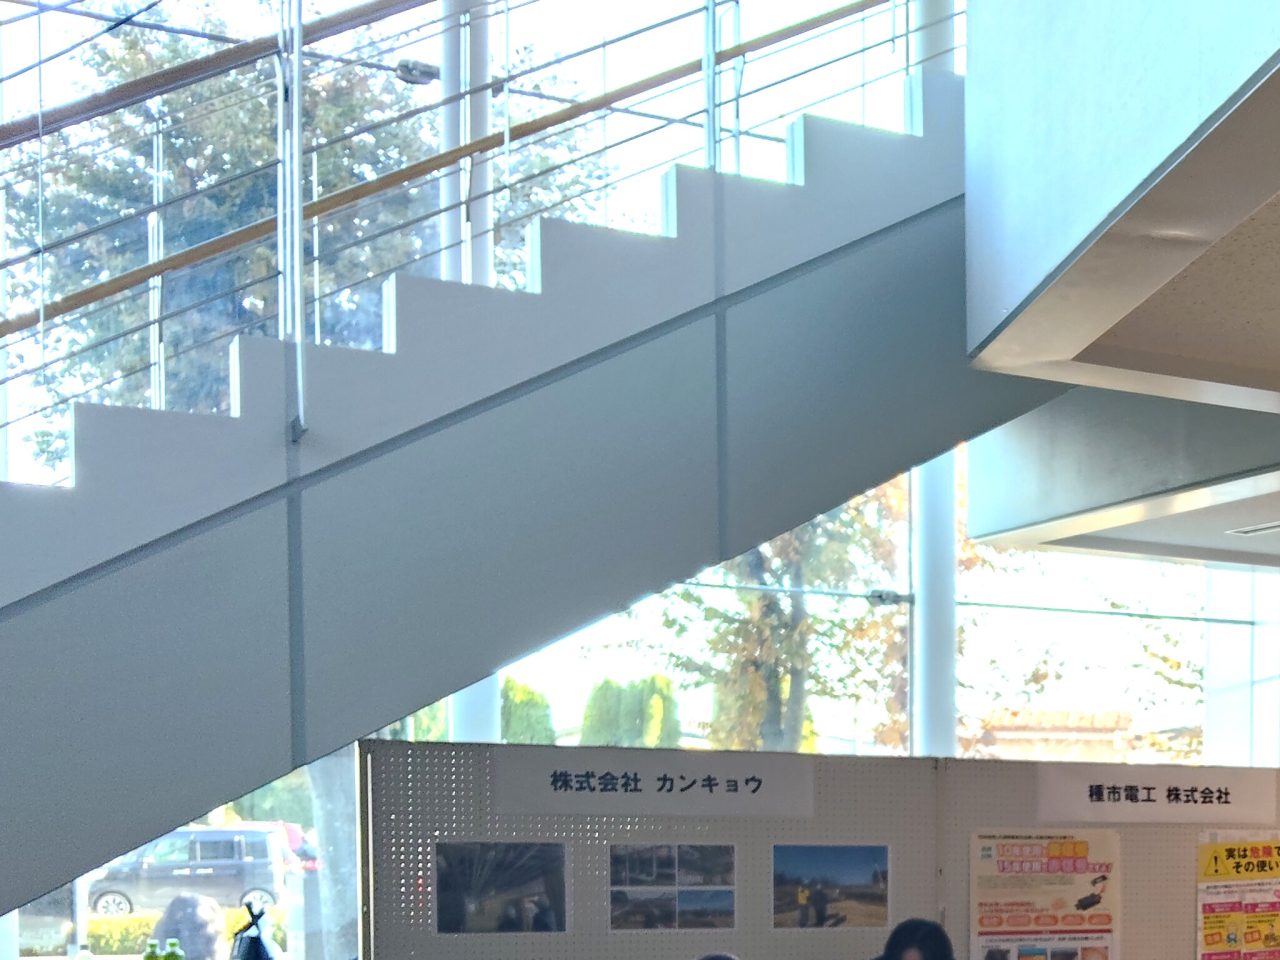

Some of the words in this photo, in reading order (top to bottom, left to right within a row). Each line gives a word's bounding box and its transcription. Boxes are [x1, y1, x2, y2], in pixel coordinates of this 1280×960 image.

[550, 769, 643, 793] 株式会社
[656, 773, 764, 795] カンキョウ
[1088, 784, 1158, 804] 種市電工
[1166, 786, 1232, 806] 株式会社
